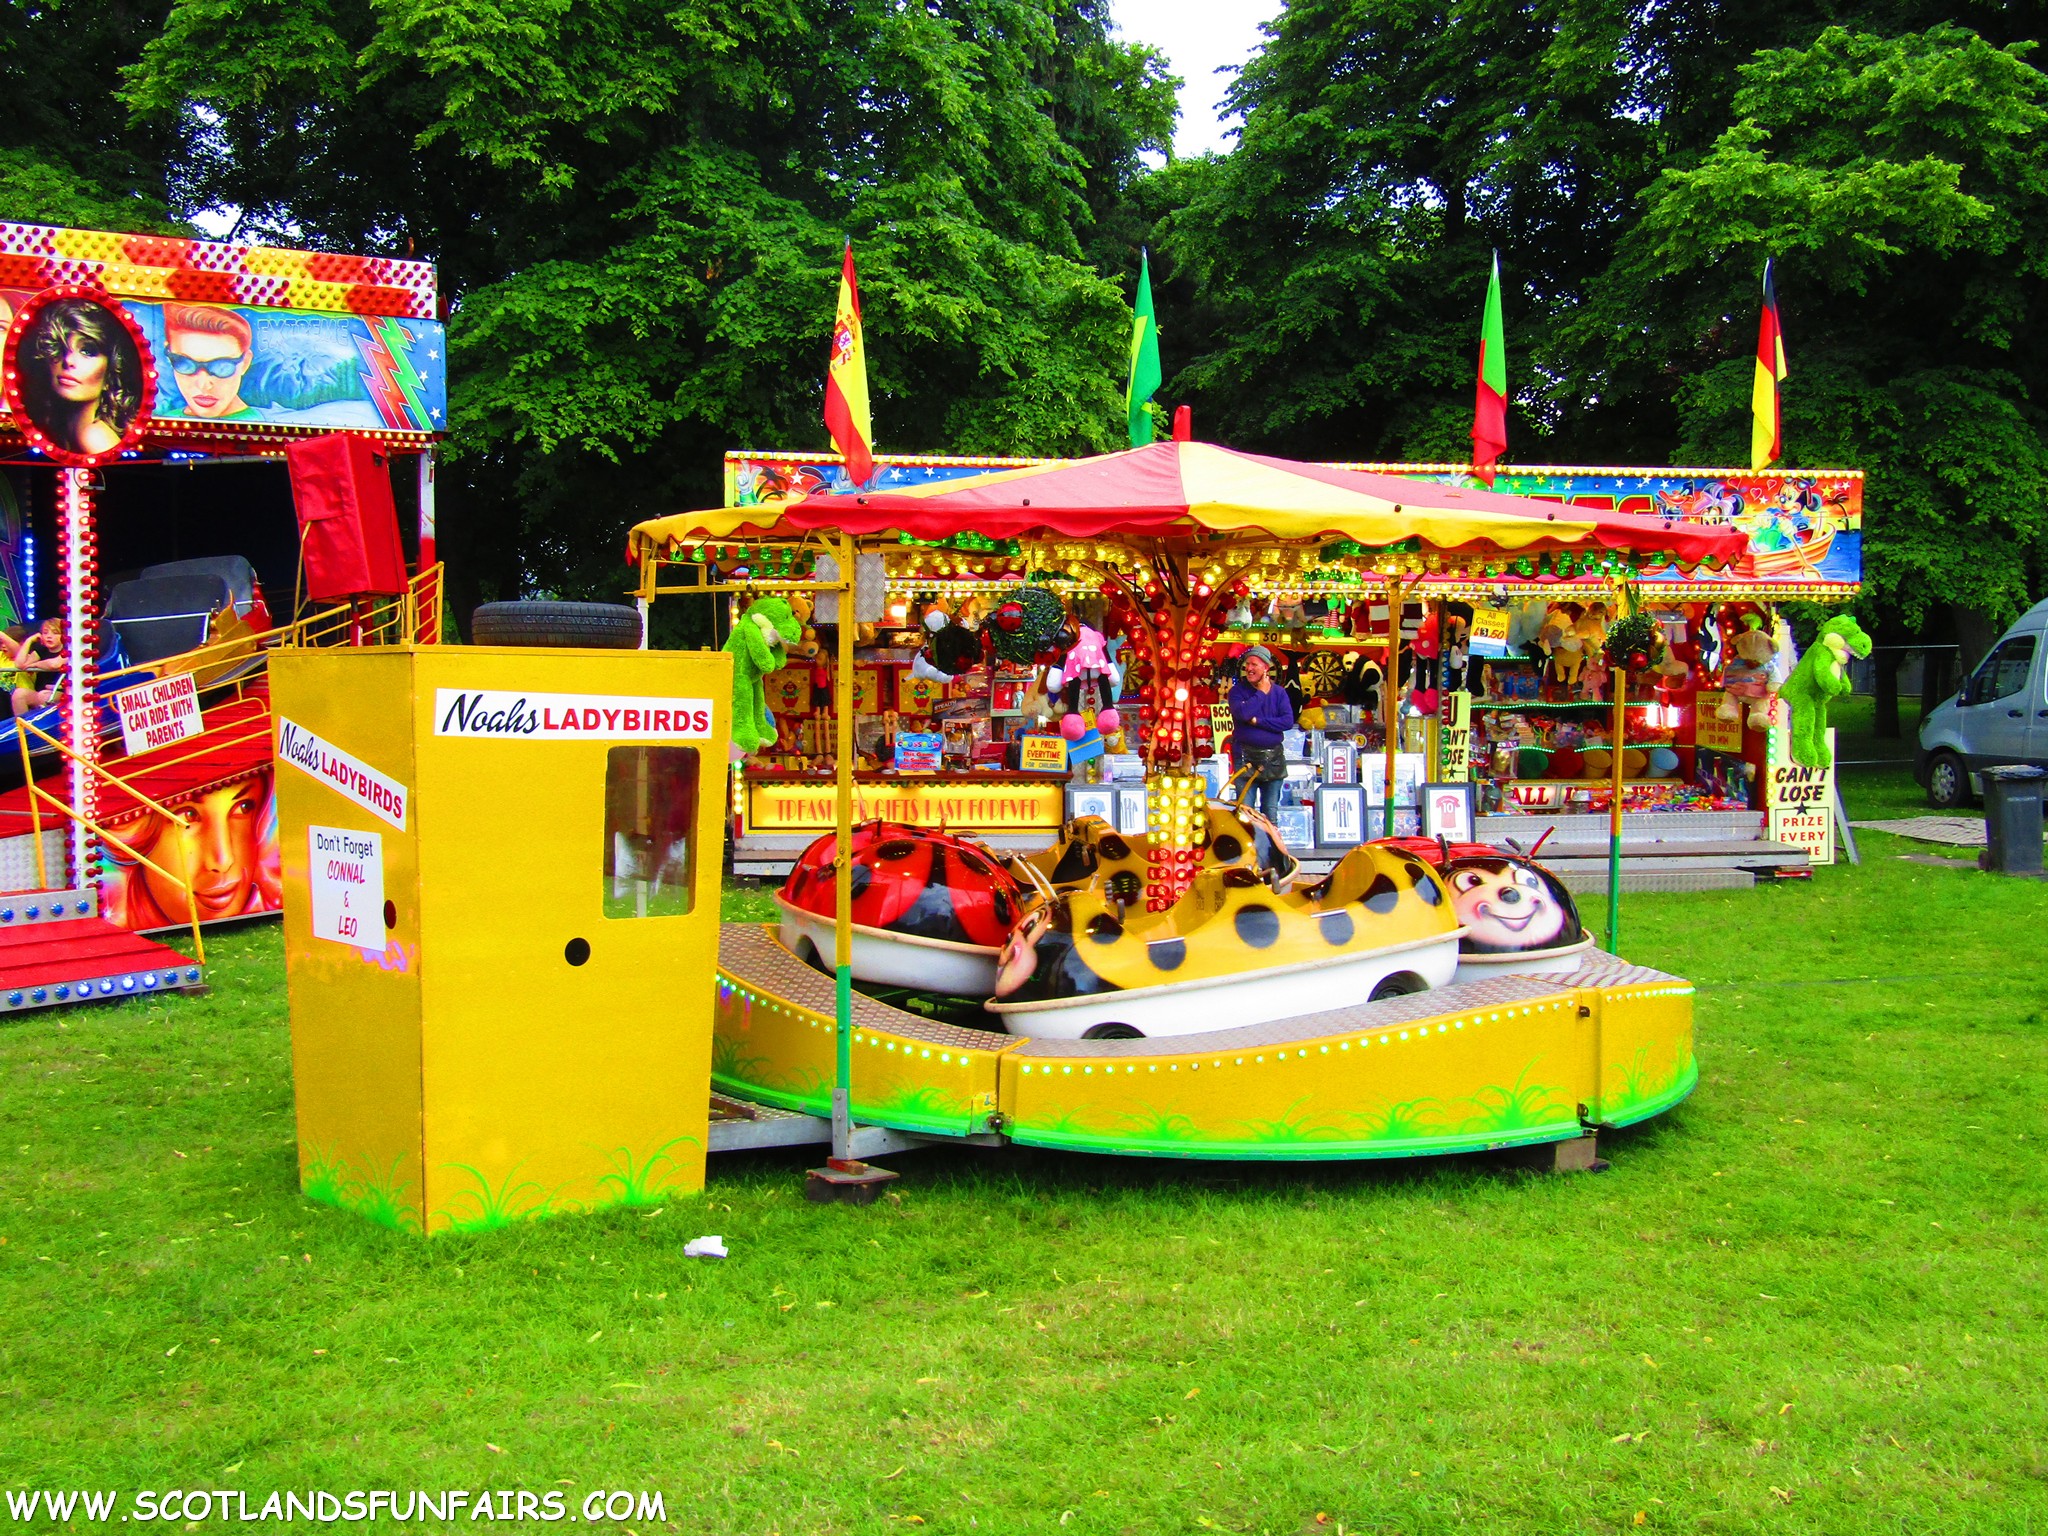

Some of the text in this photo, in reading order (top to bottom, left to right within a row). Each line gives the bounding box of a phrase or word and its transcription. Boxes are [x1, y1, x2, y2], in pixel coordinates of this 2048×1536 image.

[1475, 616, 1505, 628] Classes
[1262, 632, 1278, 642] 30
[121, 677, 194, 714] SMALL CHILDREN
[129, 698, 193, 732] CAN RIDE WITH
[442, 693, 709, 734] Noahs LADYBIRDS
[146, 720, 185, 748] PARENTS
[1030, 740, 1058, 749] A PRIZE
[1027, 751, 1061, 760] EVERYTIME
[1447, 749, 1464, 764] OSE
[279, 722, 403, 819] Noahs LADYBIRDS
[1775, 767, 1829, 783] CAN'T
[1778, 785, 1825, 802] LOSE
[775, 799, 1040, 822] TREASUED GIFTS LAST FOREVER
[1089, 805, 1096, 815] 9
[1442, 802, 1455, 813] 10
[1782, 816, 1824, 827] PRIZE
[1780, 831, 1826, 842] EVERY
[317, 833, 374, 860] Don't Forget
[326, 860, 366, 884] CONNAL
[344, 891, 351, 908] &
[338, 915, 358, 938] LEO
